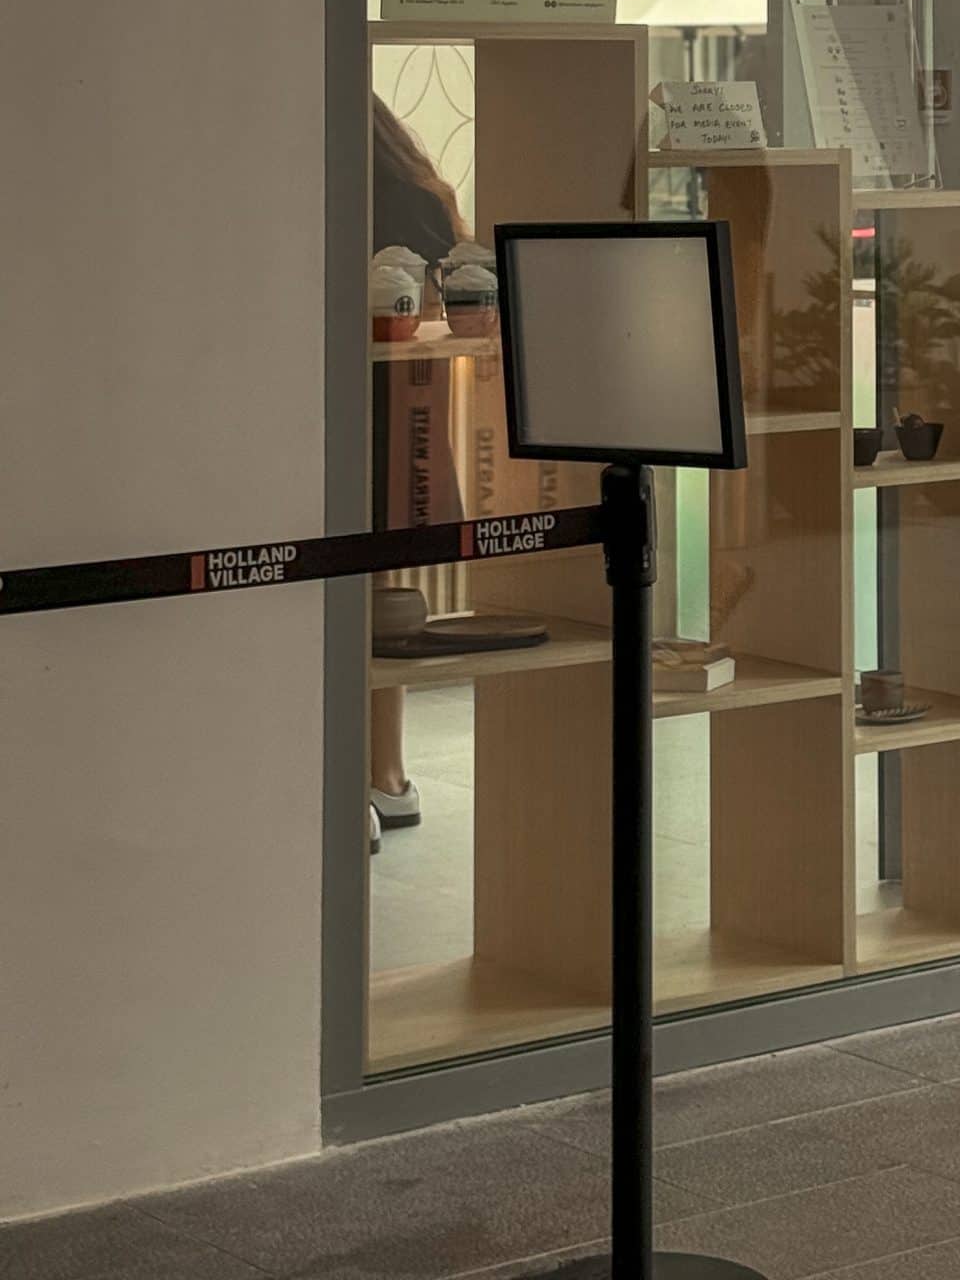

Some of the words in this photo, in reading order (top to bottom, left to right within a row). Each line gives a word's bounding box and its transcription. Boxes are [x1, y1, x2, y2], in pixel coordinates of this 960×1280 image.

[692, 103, 713, 112] ARE
[719, 103, 753, 113] CLOSED
[477, 514, 556, 539] HOLLAND
[477, 532, 546, 556] VILLAGE
[208, 545, 297, 570] HOLLAND
[209, 564, 285, 587] VILLAGE
